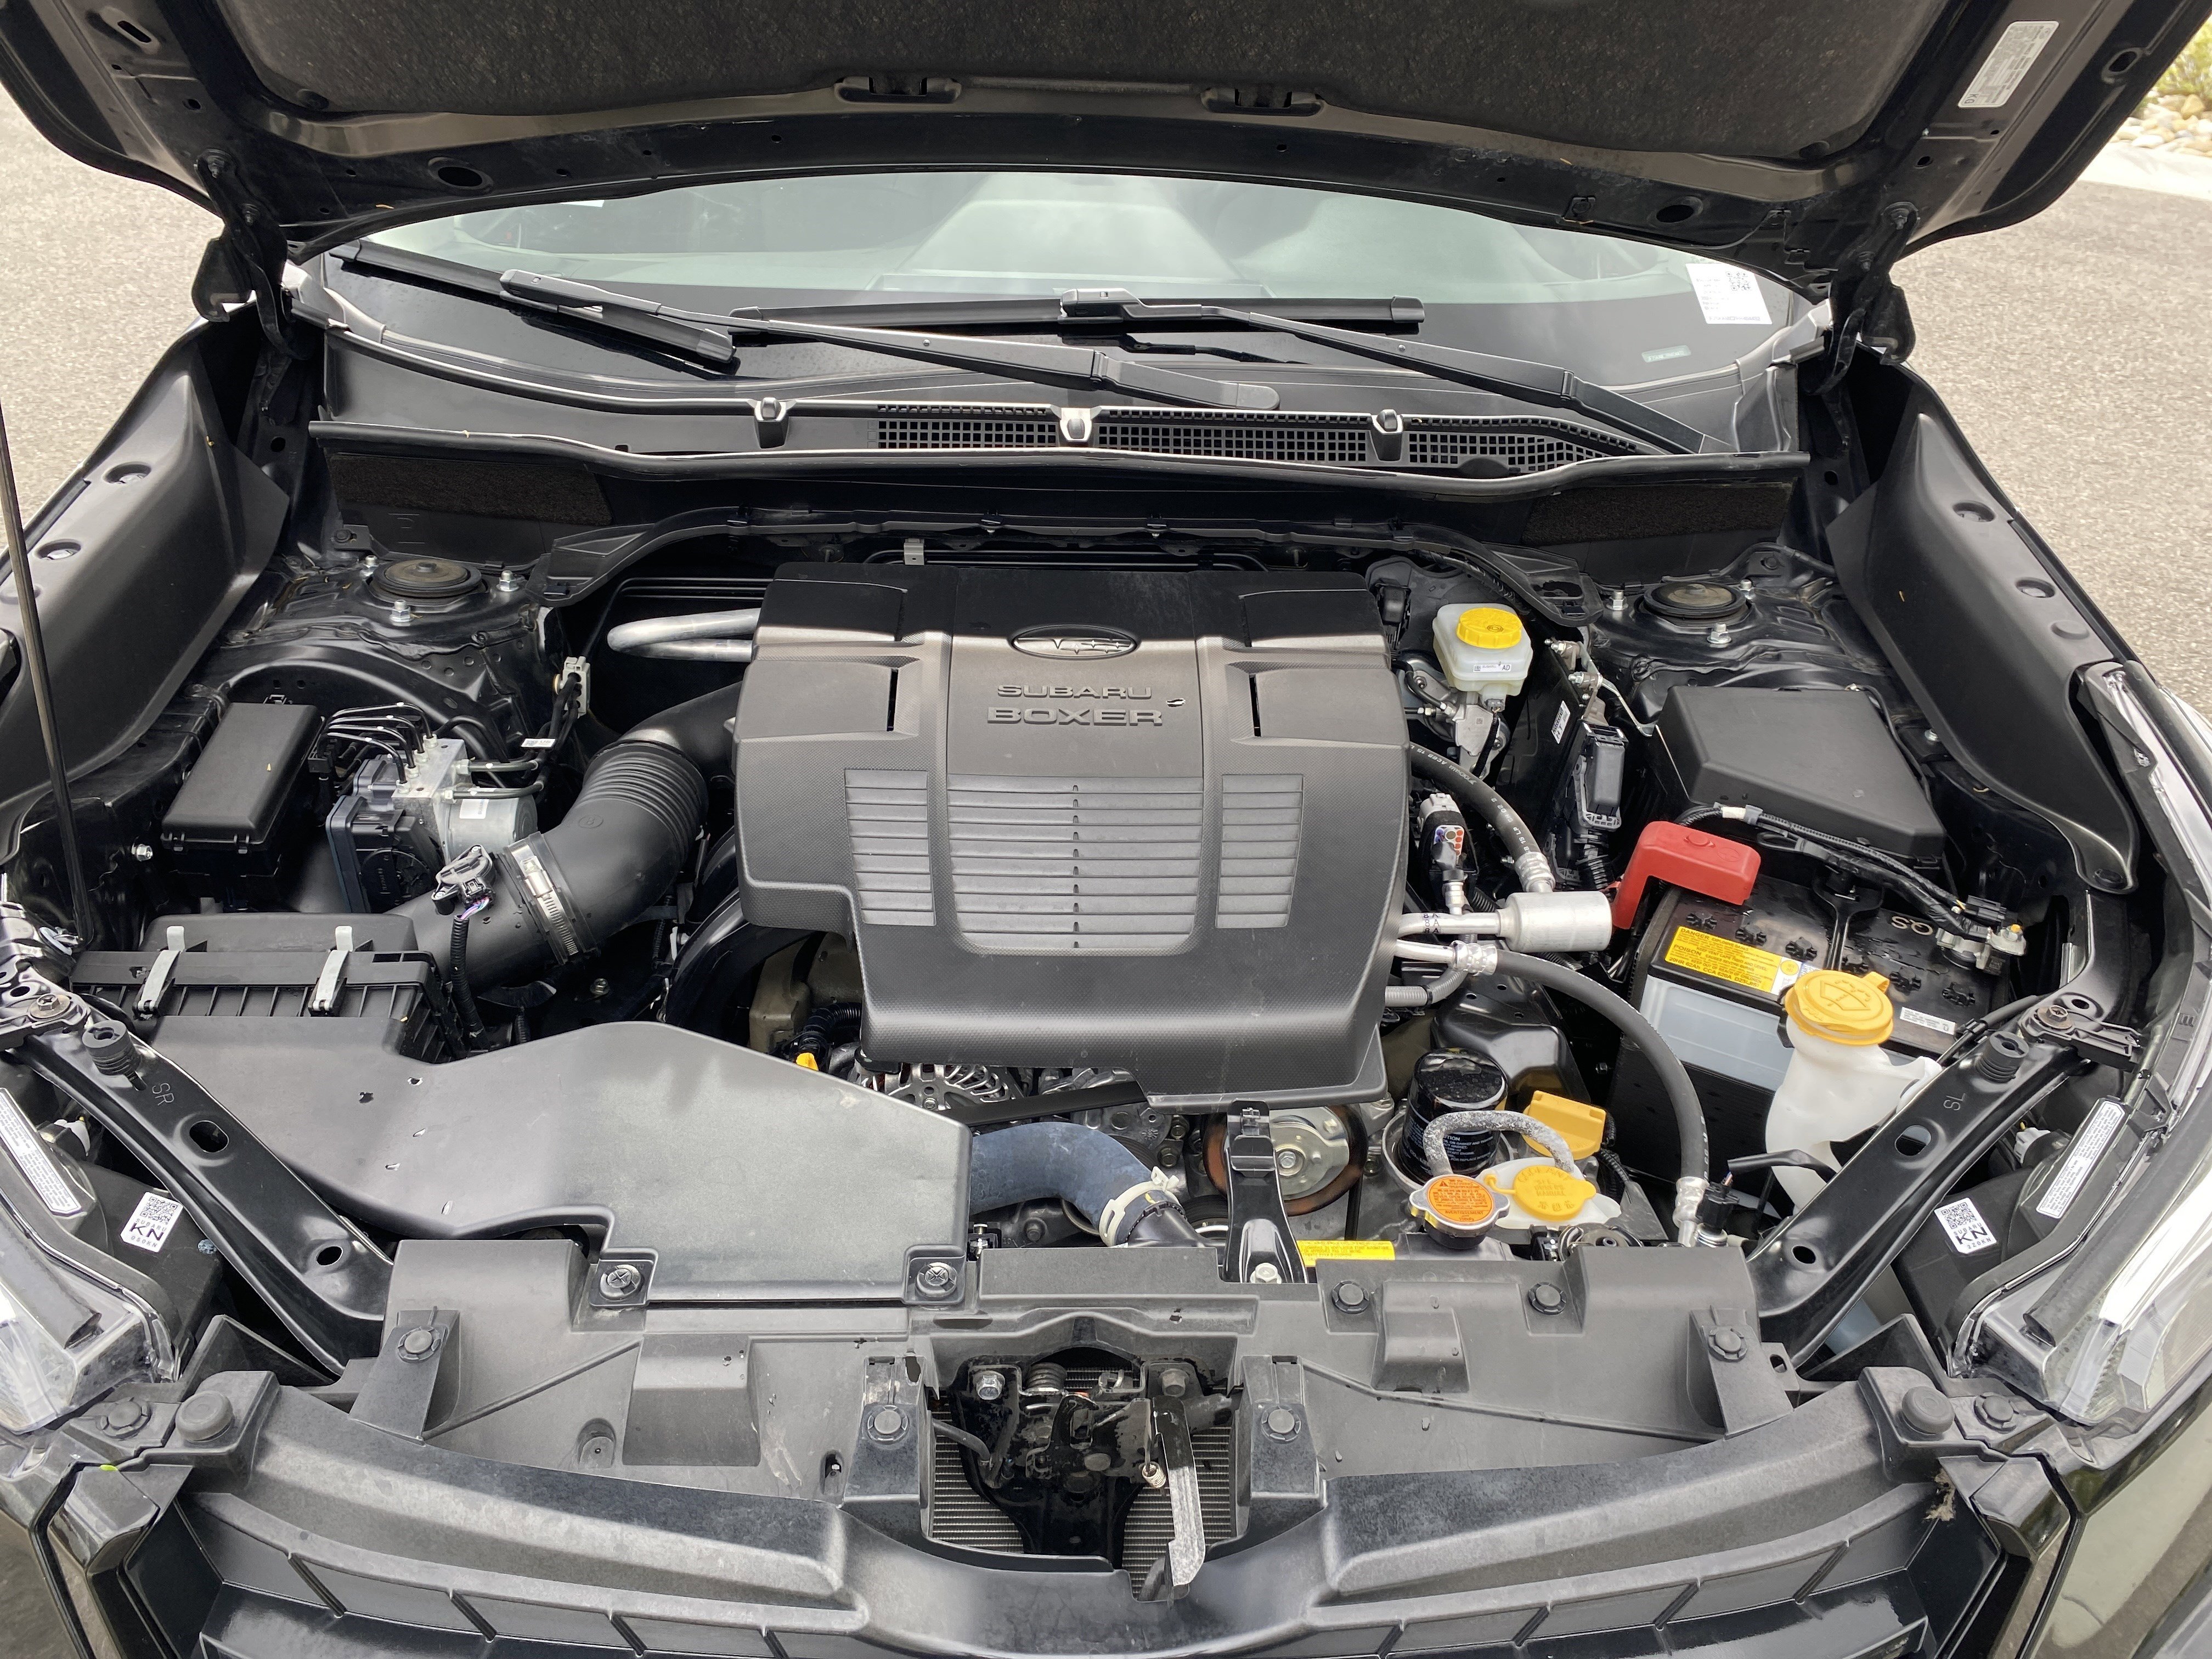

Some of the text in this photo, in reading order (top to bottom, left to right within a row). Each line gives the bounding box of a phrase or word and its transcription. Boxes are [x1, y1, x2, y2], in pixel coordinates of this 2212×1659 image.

[997, 685, 1152, 699] SUBARU
[988, 707, 1163, 726] BOXER
[1513, 826, 1522, 836] LP
[1519, 837, 1526, 845] 15
[1680, 928, 1710, 940] DANGER
[1674, 944, 1702, 956] POISON
[1703, 967, 1717, 975] CCA
[151, 1082, 174, 1107] SR
[1943, 1093, 1966, 1111] SL
[129, 1222, 164, 1241] KN
[136, 1218, 167, 1232] SUBARU
[1953, 1223, 1982, 1236] SUBARU
[1955, 1227, 1988, 1245] KN
